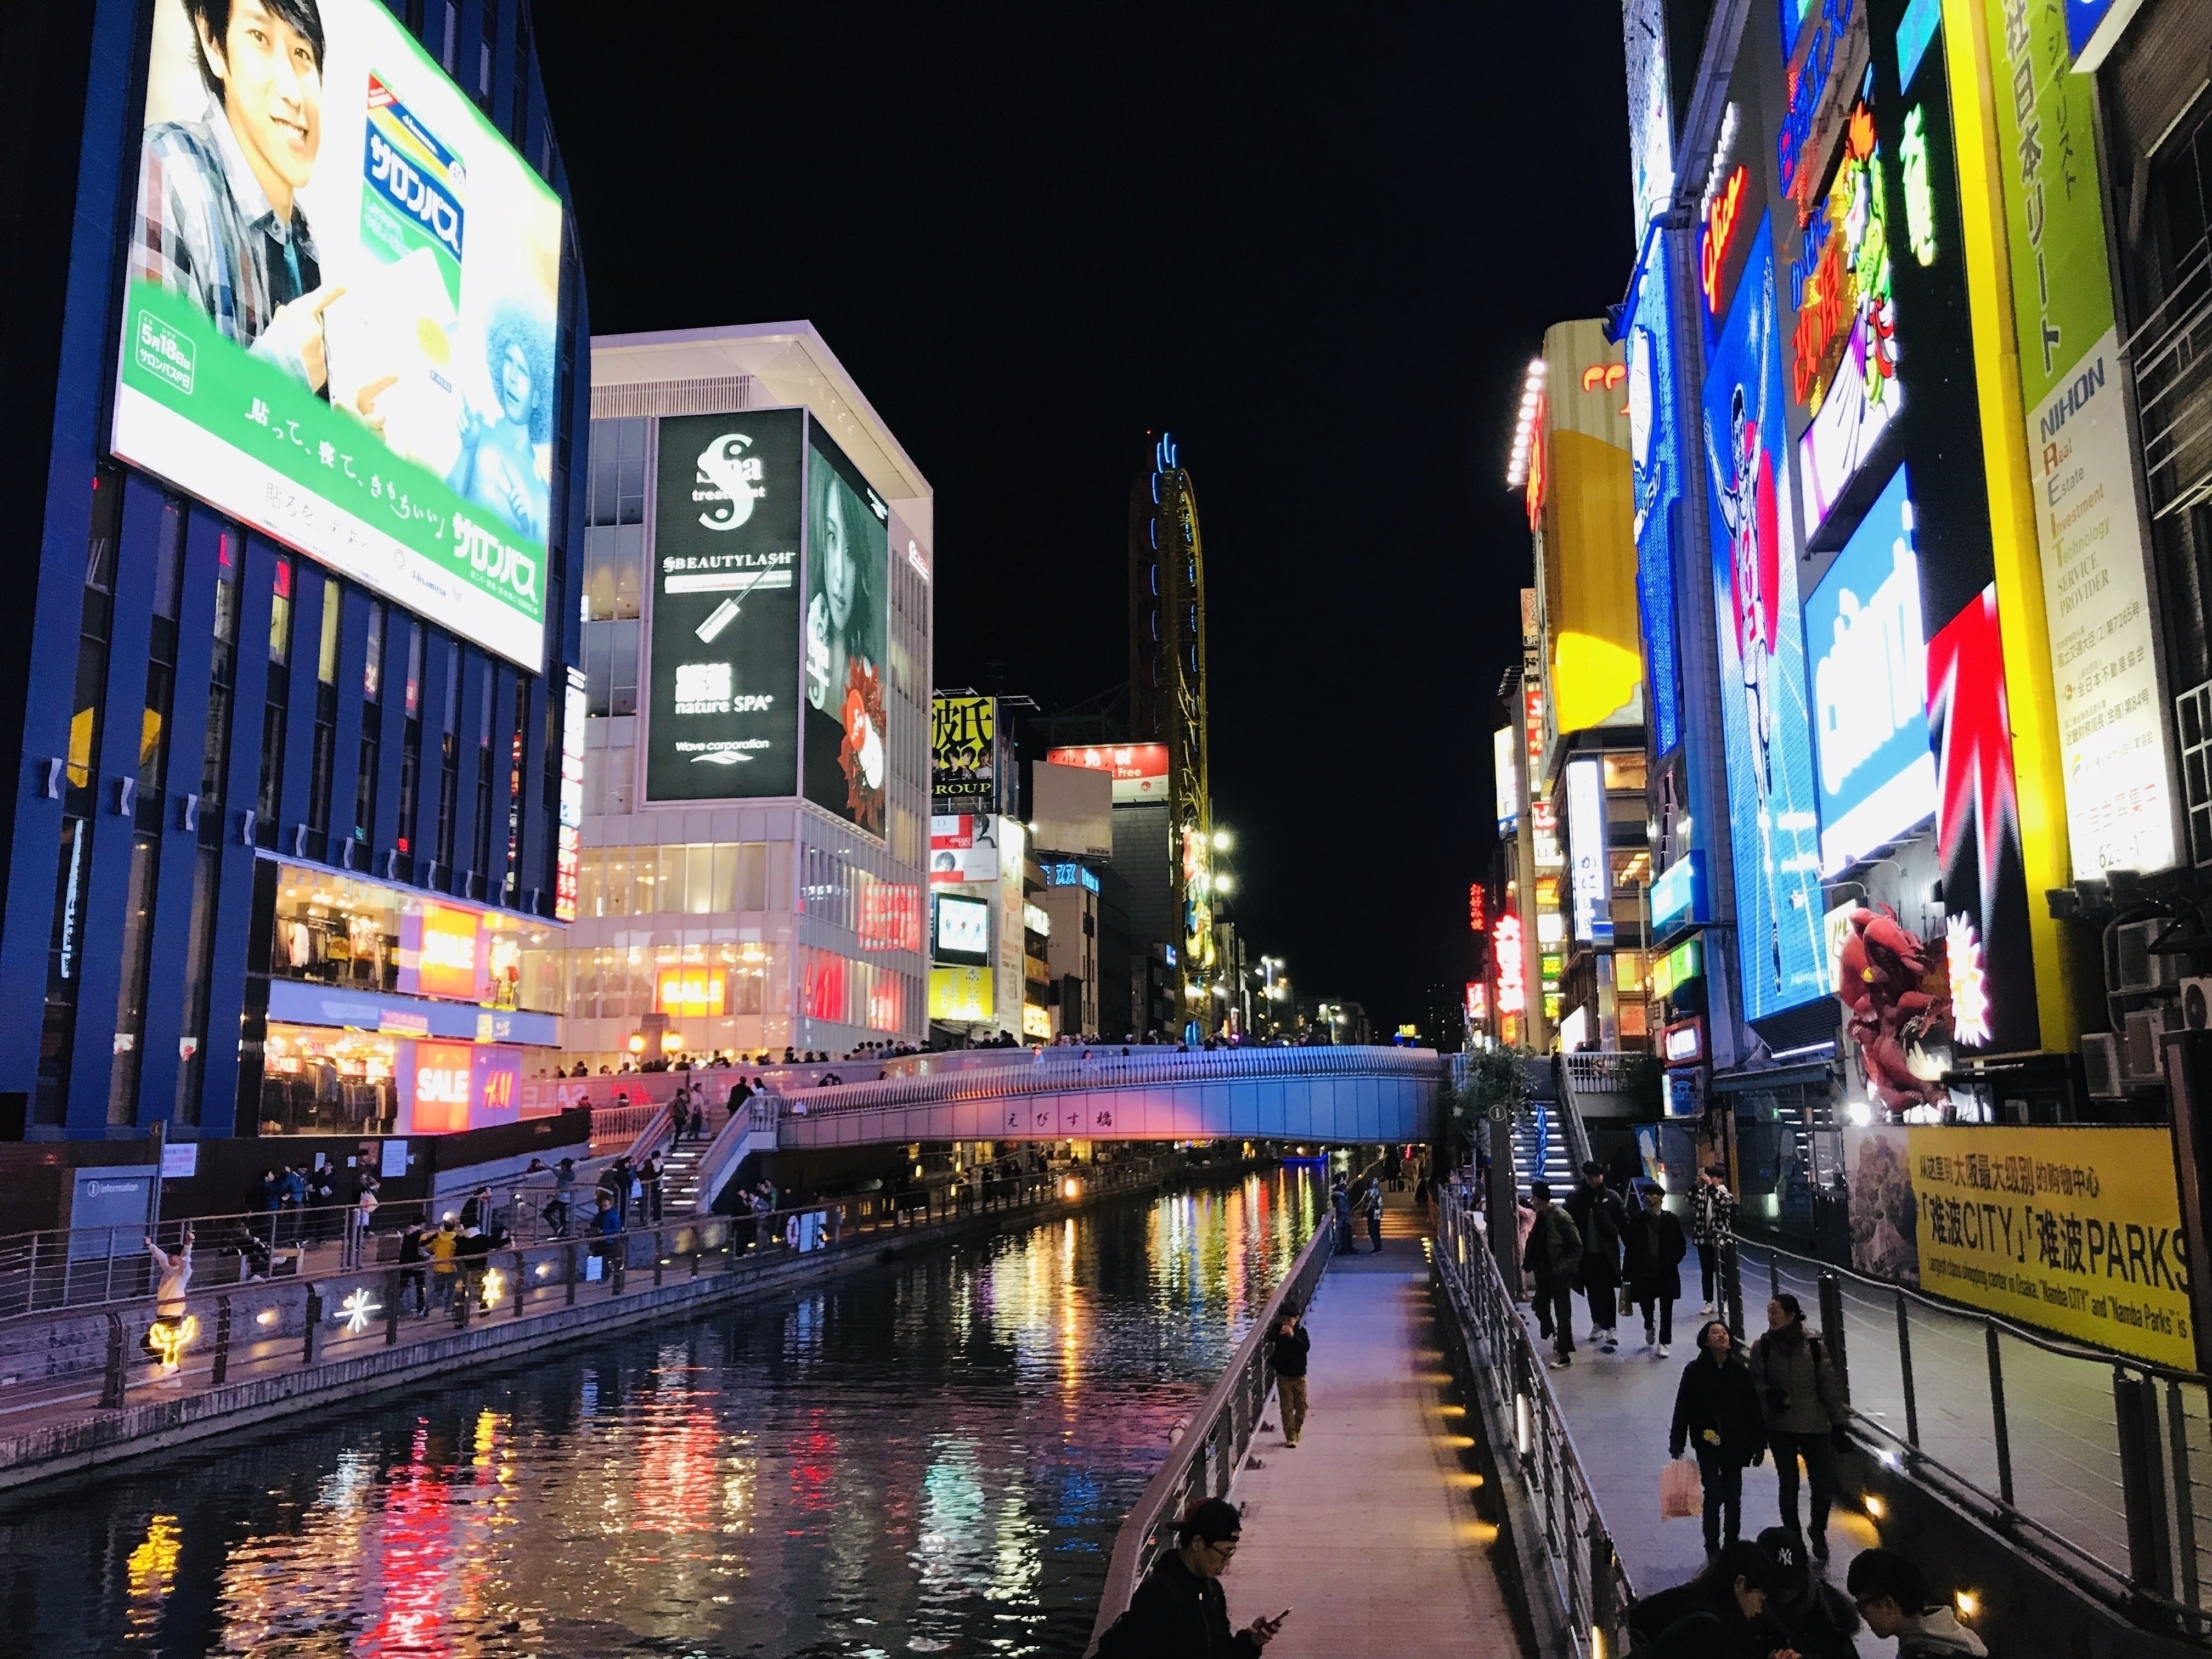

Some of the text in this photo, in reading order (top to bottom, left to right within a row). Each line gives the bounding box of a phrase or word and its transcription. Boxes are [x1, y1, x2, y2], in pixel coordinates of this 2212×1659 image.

[371, 134, 458, 251] サロンパス
[1702, 166, 1743, 313] Glico
[1791, 195, 1831, 311] かぜに
[1791, 238, 1842, 405] 改源
[139, 348, 190, 389] サロンパスの日
[141, 323, 191, 370] 5月18日は
[2040, 357, 2104, 444] NIHON
[2044, 438, 2072, 476] Real
[2048, 466, 2084, 507] Estate
[2051, 484, 2104, 540] Investment
[453, 512, 536, 602] サロンパス
[2052, 516, 2109, 569] Technology
[1742, 518, 1757, 643] グリコ
[2057, 551, 2098, 596] SERVICE
[2060, 569, 2109, 617] PROVIDER
[2077, 645, 2145, 698] 全日本不動産協会
[676, 695, 768, 714] nature SPA
[676, 739, 769, 752] Wave corporation
[932, 783, 991, 794] ROUP
[1118, 768, 1142, 777] Free
[1470, 883, 1483, 930] お好み焼
[423, 930, 475, 969] SALE
[1541, 944, 1556, 952] 1F
[661, 980, 722, 1003] SALE
[417, 1068, 470, 1103] SALE
[1008, 1111, 1112, 1127] えびす橋
[1927, 1252, 1948, 1277] Largest
[1962, 1263, 1987, 1291] shopping
[1988, 1271, 2006, 1290] center
[2092, 1295, 2108, 1318] and
[2177, 1318, 2187, 1339] is
[1778, 1547, 1793, 1566] NY
